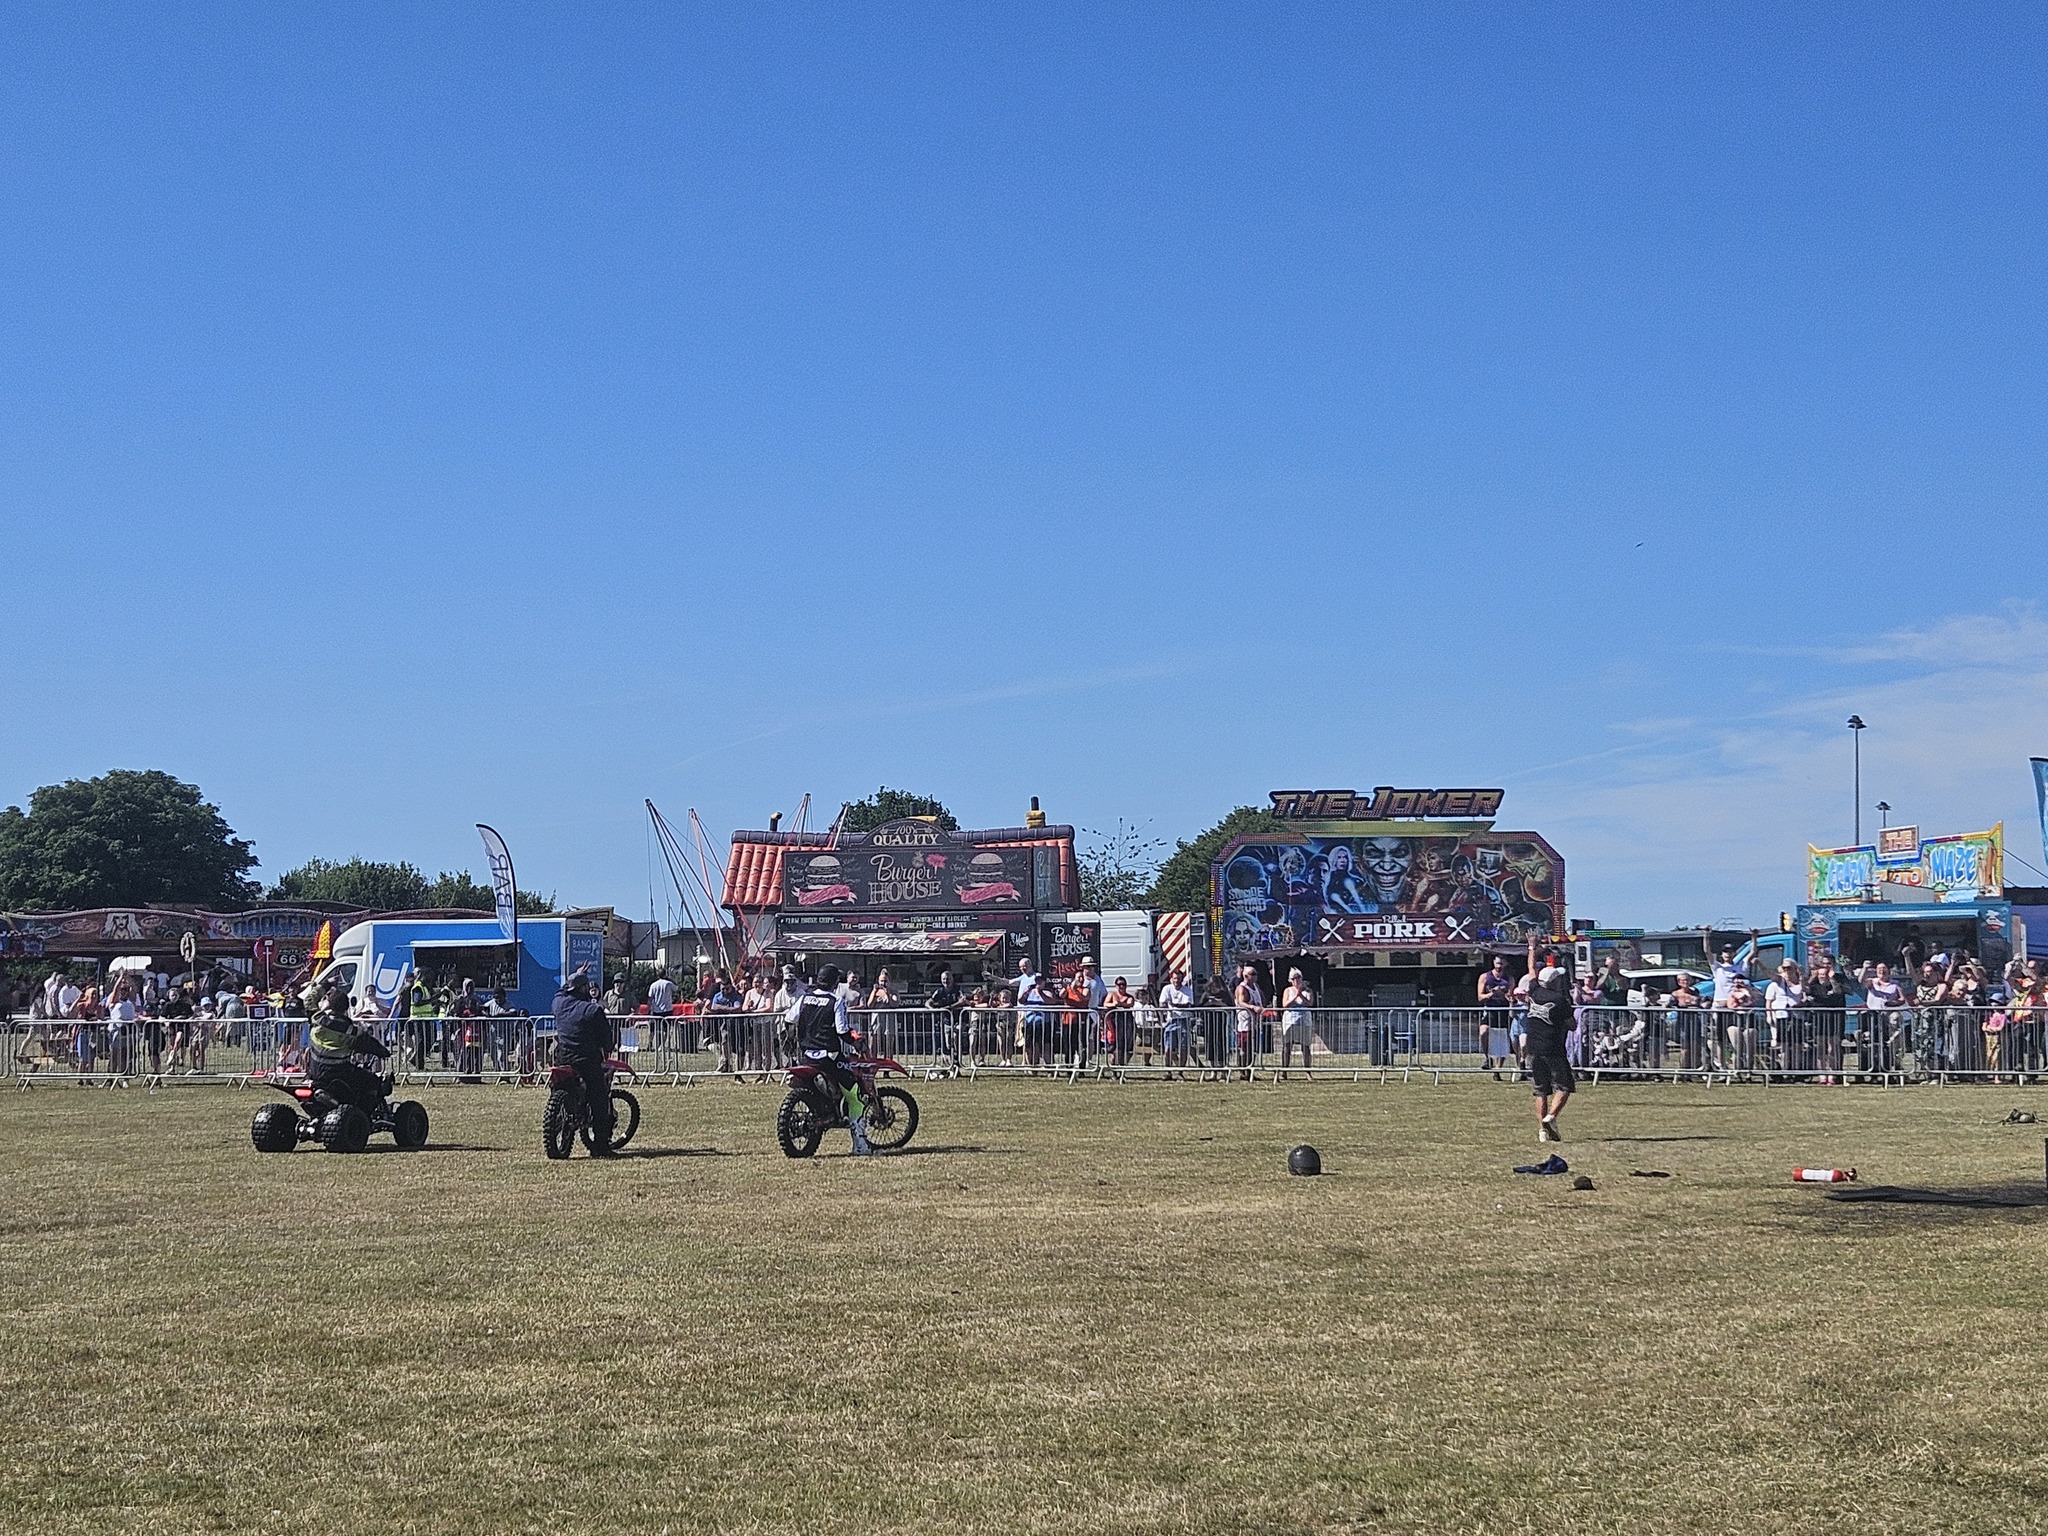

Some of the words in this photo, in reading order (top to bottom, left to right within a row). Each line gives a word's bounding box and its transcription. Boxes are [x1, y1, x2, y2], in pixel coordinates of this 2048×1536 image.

[1270, 791, 1353, 817] THE
[1350, 787, 1503, 818] JOKER
[872, 833, 941, 846] QUALITY
[1885, 830, 1913, 851] THE
[1827, 854, 1872, 895] CRAZY
[1930, 846, 1977, 887] MAZE
[868, 881, 942, 905] HOUSE
[1228, 886, 1265, 899] SUICIDE
[1353, 922, 1437, 938] PORK
[1050, 943, 1091, 957] HOUSE
[280, 954, 297, 965] 66
